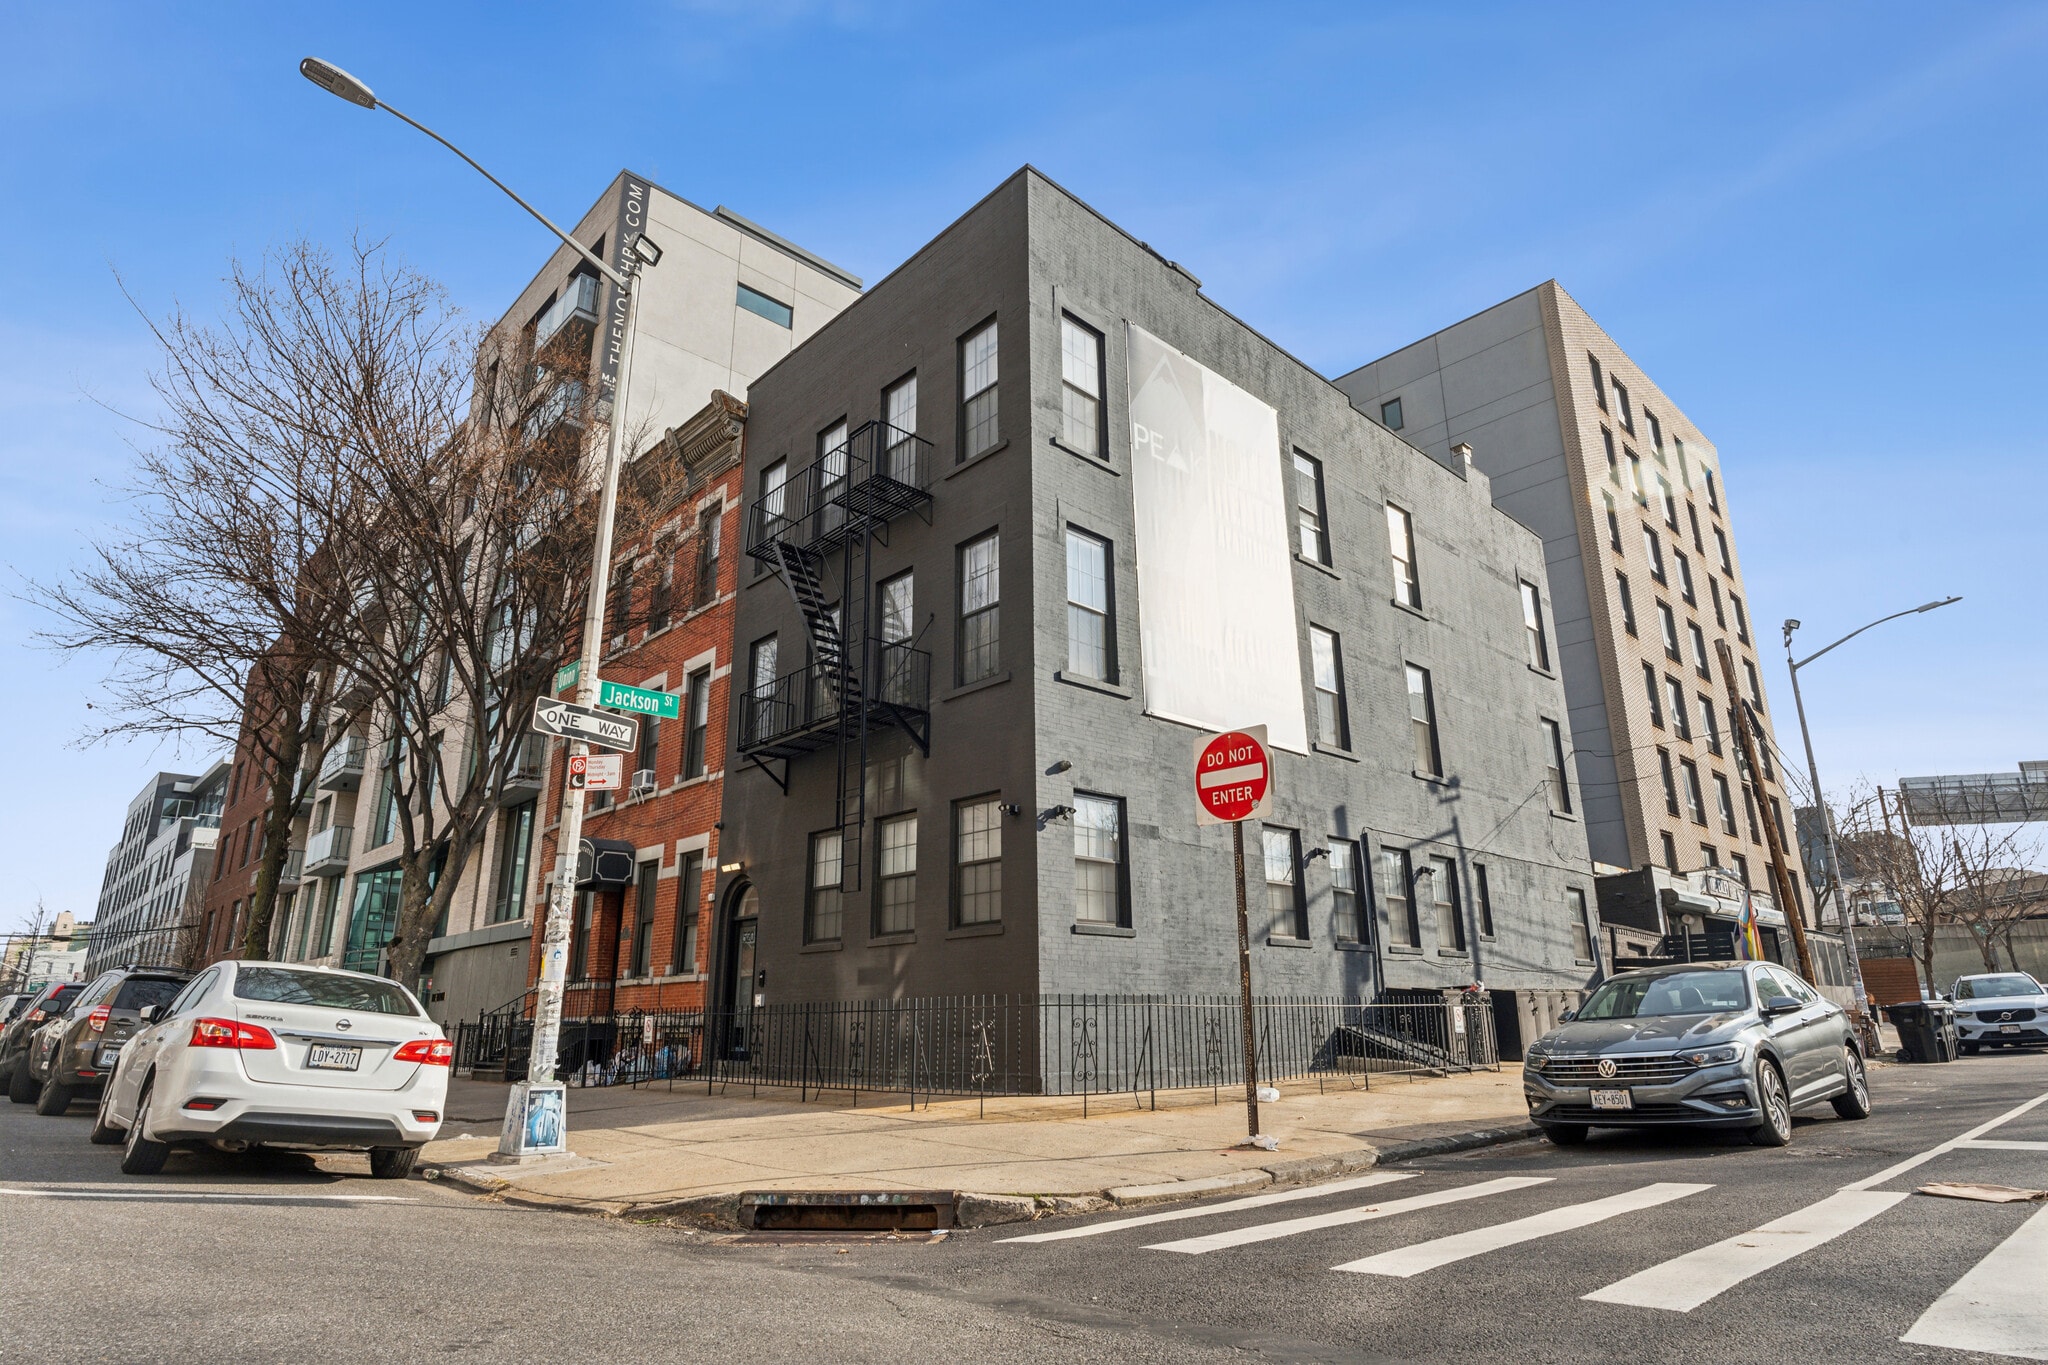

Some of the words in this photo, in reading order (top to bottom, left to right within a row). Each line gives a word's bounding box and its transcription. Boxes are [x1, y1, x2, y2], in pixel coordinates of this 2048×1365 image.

[605, 686, 659, 713] Jackson
[664, 695, 673, 707] St
[546, 711, 582, 728] ONE
[599, 721, 628, 739] WAY
[1207, 752, 1224, 767] DO
[1229, 746, 1253, 763] NOT
[1212, 786, 1253, 805] ENTER
[312, 1050, 330, 1063] LDY
[334, 1052, 357, 1065] 2717
